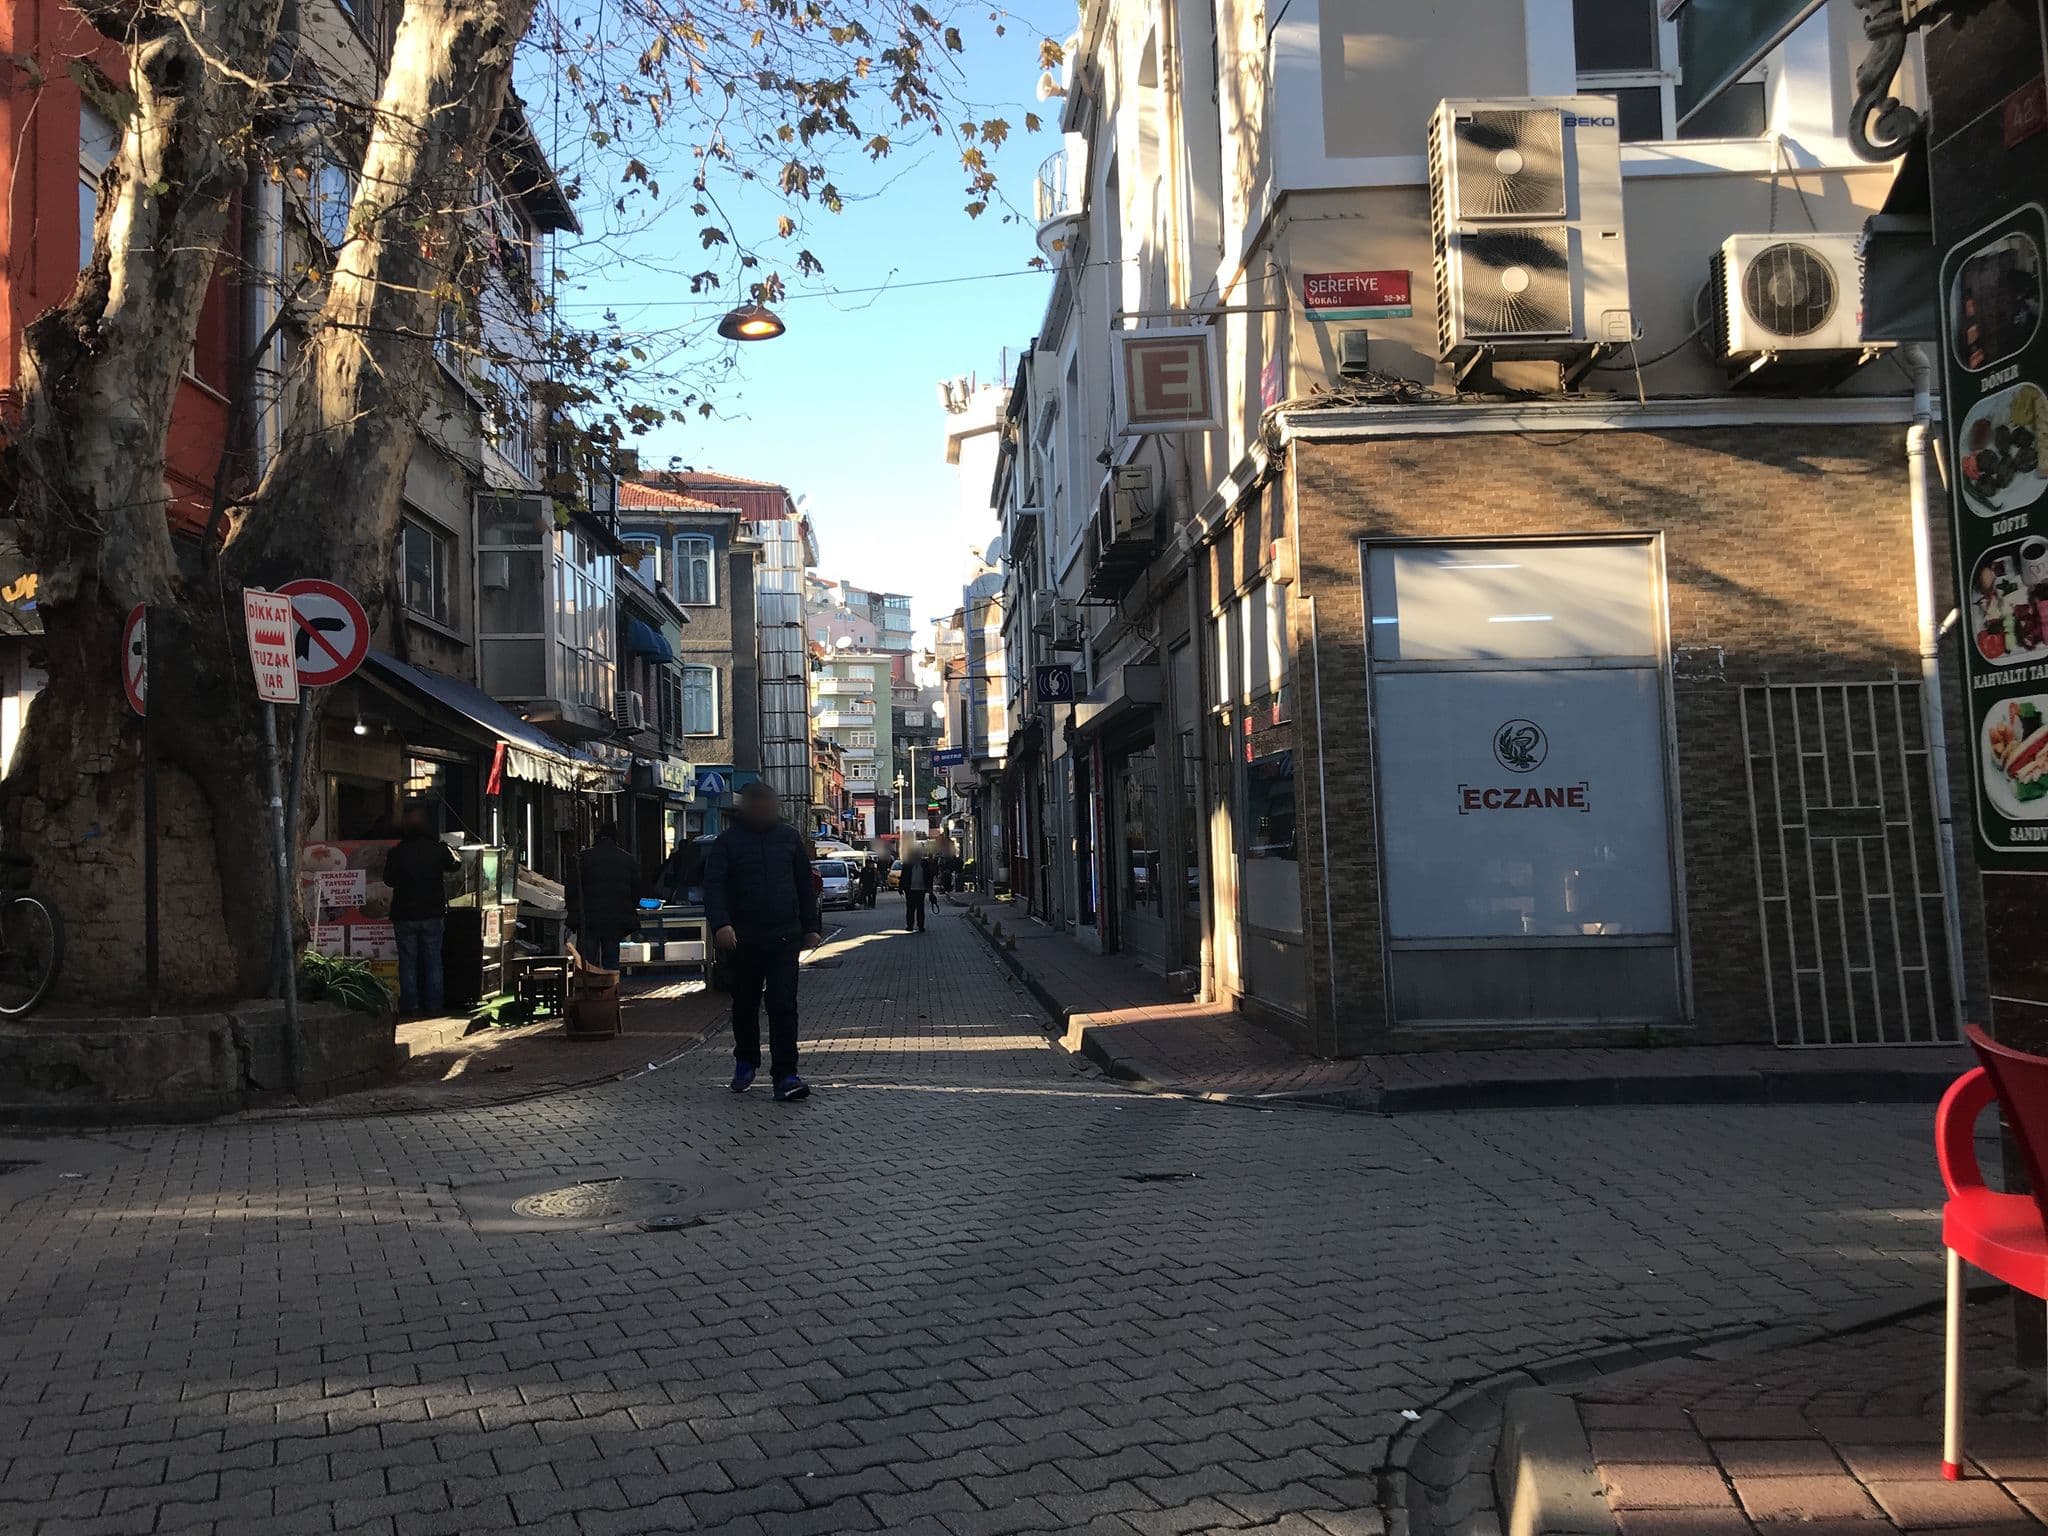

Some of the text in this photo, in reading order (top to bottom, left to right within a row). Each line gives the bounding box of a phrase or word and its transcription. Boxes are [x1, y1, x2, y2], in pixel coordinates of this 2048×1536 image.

[1564, 117, 1615, 127] BEKO
[1308, 275, 1379, 296] ŞEREFİYE
[1308, 295, 1342, 305] SOKAĞI
[1141, 350, 1192, 410] E
[1980, 363, 2019, 393] DÖNER
[1992, 513, 2029, 538] KÖFTE
[249, 602, 288, 623] DİKKAT
[254, 650, 290, 668] TUZAK
[262, 672, 284, 689] VAR
[1973, 667, 2028, 690] KAHVALTI
[1463, 787, 1585, 810] ECZANE
